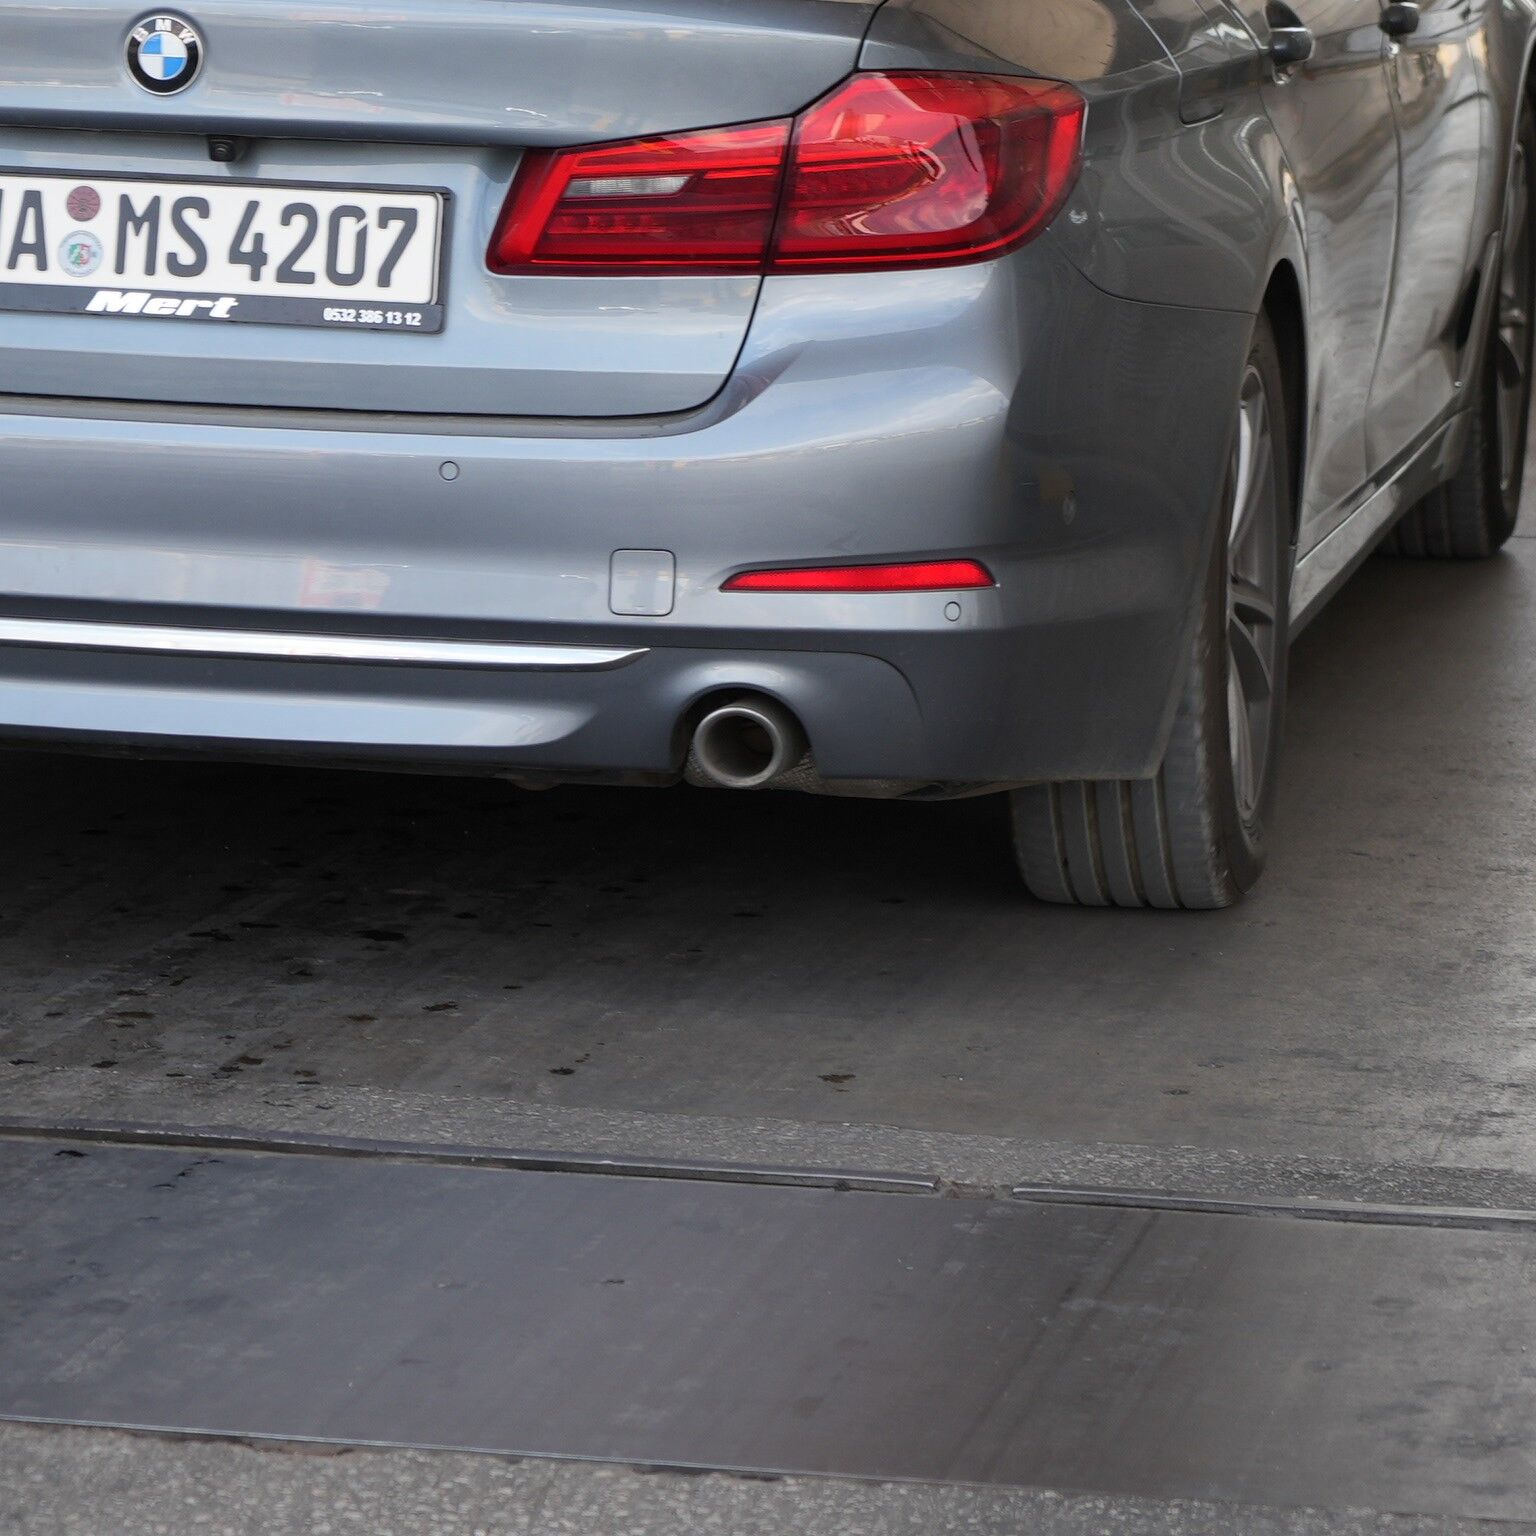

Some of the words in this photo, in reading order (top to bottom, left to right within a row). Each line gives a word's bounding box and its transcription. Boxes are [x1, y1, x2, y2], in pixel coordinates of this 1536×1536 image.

[132, 18, 196, 44] BMW
[114, 193, 210, 278] MS
[228, 200, 418, 288] 4207
[85, 290, 239, 319] Mert
[385, 311, 403, 325] 13
[404, 312, 422, 326] 12
